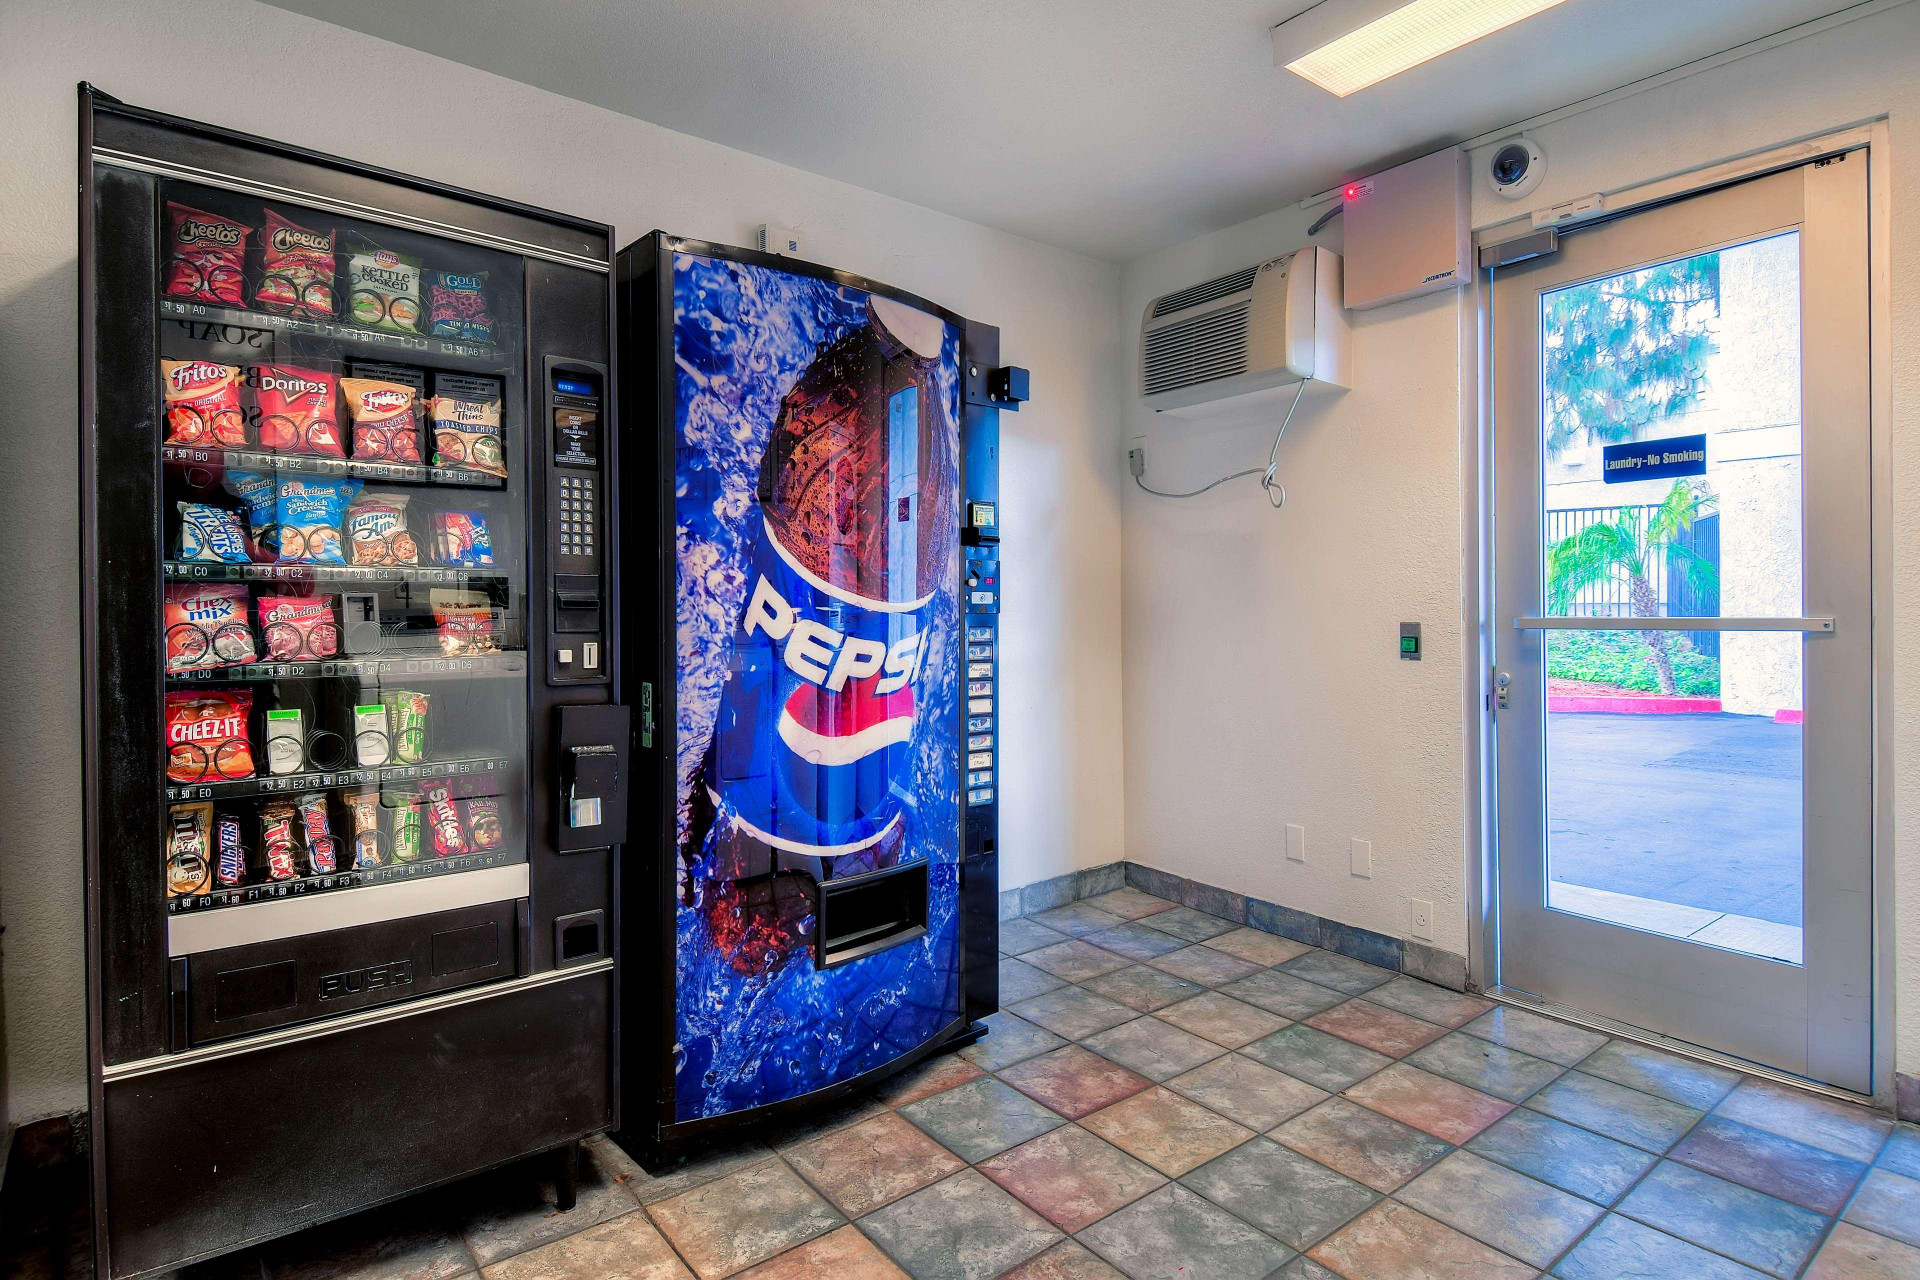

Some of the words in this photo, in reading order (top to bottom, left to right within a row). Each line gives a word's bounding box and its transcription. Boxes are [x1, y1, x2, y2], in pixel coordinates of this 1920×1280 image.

[178, 220, 241, 244] Cheetos
[273, 228, 331, 252] Cheetos
[446, 275, 483, 289] GOLD
[164, 301, 185, 314] $1.50
[192, 306, 206, 315] A0
[286, 321, 299, 329] A2
[467, 346, 480, 356] A6
[170, 362, 227, 391] Fritos
[262, 376, 328, 394] Doritos
[194, 394, 227, 406] ORIGINAL
[453, 401, 484, 414] Wheat
[452, 411, 484, 421] Thins
[440, 421, 471, 433] TOASTED
[475, 425, 498, 435] CHIPS
[166, 449, 187, 460] $1.50
[195, 452, 209, 462] B0
[1663, 449, 1704, 465] Smoking
[289, 460, 302, 469] B2
[377, 467, 389, 475] B4
[458, 471, 469, 481] B6
[211, 508, 231, 523] RICE
[187, 509, 232, 554] TREATS
[165, 565, 188, 574] $2.00
[194, 567, 208, 576] C0
[264, 568, 285, 577] $2.00
[291, 568, 303, 578] C2
[377, 570, 389, 579] C4
[458, 571, 468, 580] C6
[181, 594, 233, 612] Chex
[189, 604, 234, 621] mix
[743, 573, 928, 697] PEPSI
[198, 669, 212, 679] D0
[268, 666, 286, 677] $1.50
[292, 666, 305, 675] D2
[379, 664, 391, 672] D4
[171, 717, 241, 742] CHEEZ-IT
[422, 768, 432, 777] E5
[459, 763, 470, 773] E6
[312, 776, 331, 787] $2.50
[338, 775, 349, 785] E3
[356, 772, 374, 782] $2.50
[381, 771, 392, 780] E4
[266, 779, 286, 791] $2.50
[293, 779, 305, 788] E2
[167, 789, 190, 800] $1.50
[199, 788, 212, 798] E0
[430, 788, 459, 848] Skittles
[220, 822, 238, 879] SNICKERS
[264, 819, 294, 880] TWIX
[423, 864, 433, 873] F5
[460, 858, 471, 867] F6
[382, 870, 392, 879] F4
[339, 876, 350, 886] F3
[268, 887, 287, 896] $1.60
[294, 883, 305, 893] F2
[221, 895, 240, 904] $1.60
[249, 890, 259, 900] F1
[169, 899, 191, 911] $1.60
[199, 896, 211, 906] F0
[321, 964, 410, 999] PUSH
